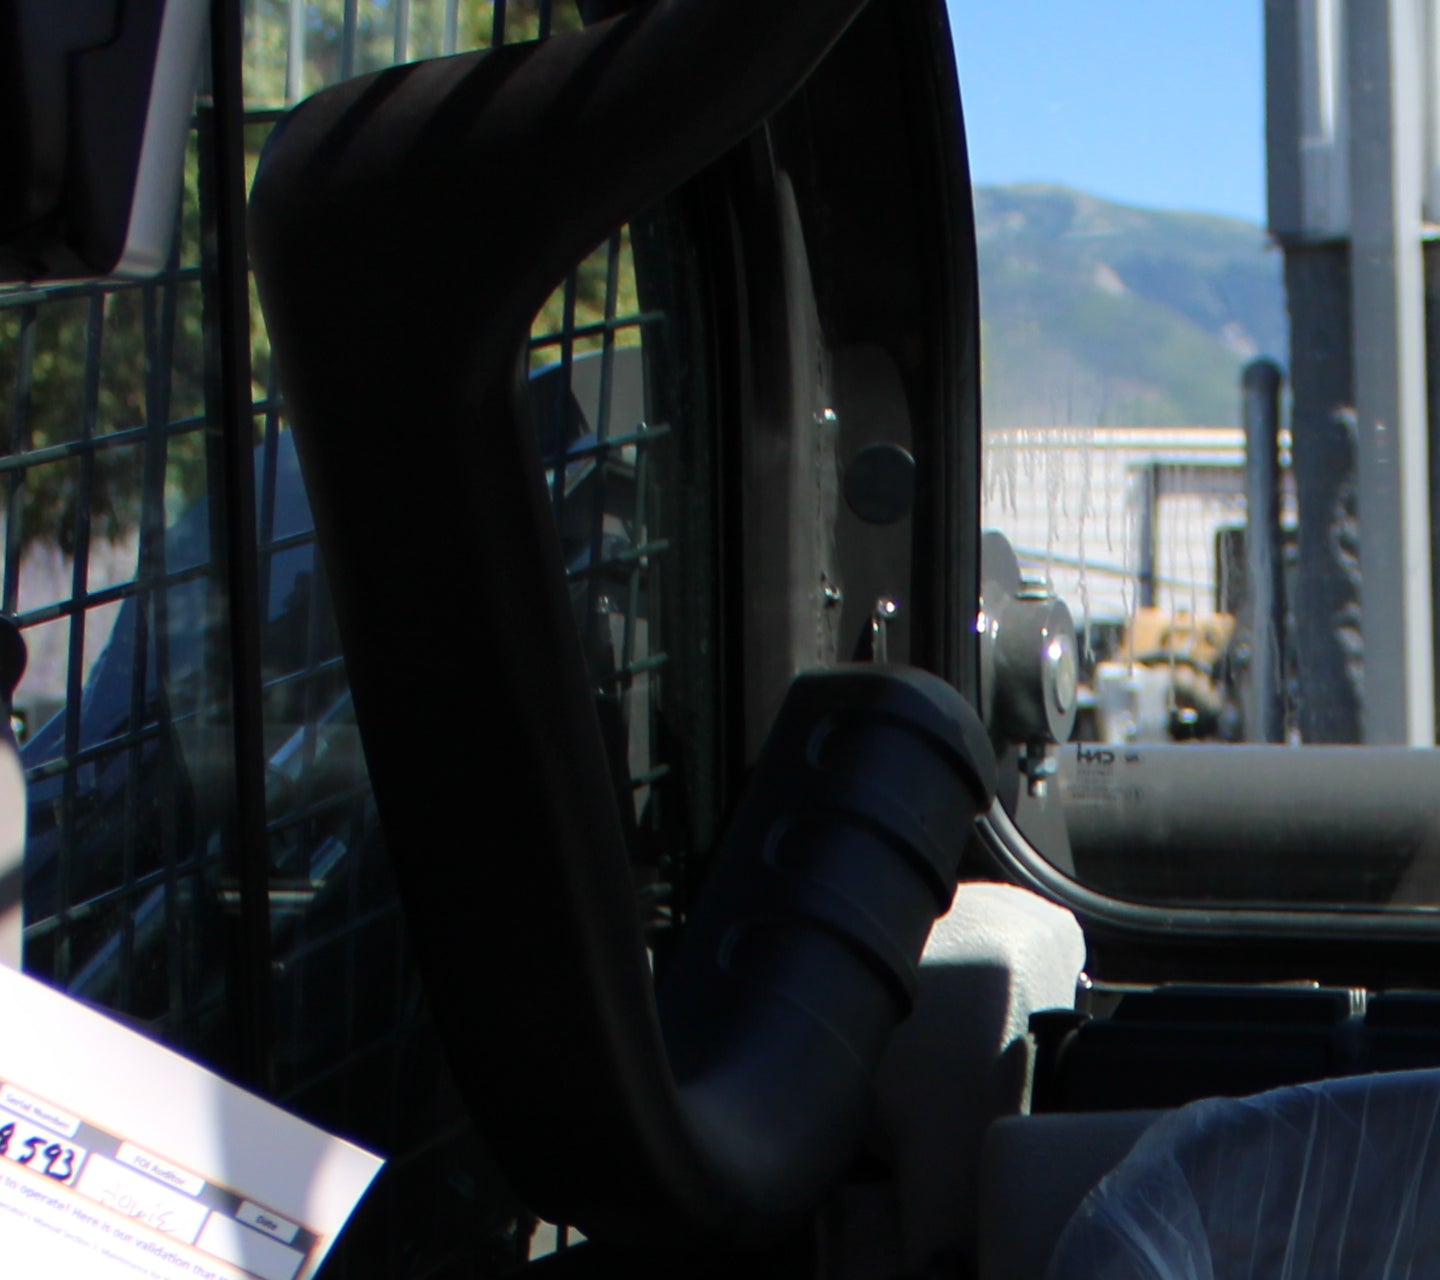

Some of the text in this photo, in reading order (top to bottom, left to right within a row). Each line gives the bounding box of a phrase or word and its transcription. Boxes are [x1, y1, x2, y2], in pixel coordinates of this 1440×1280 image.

[6, 1094, 70, 1129] Serial Number
[151, 1165, 185, 1185] Auditor
[4, 1176, 18, 1189] to
[20, 1185, 70, 1210] operate!
[72, 1208, 99, 1226] Here
[101, 1222, 111, 1232] is
[113, 1229, 133, 1242] our
[135, 1240, 190, 1269] validation
[192, 1265, 216, 1280] that
[256, 1215, 277, 1231] Date
